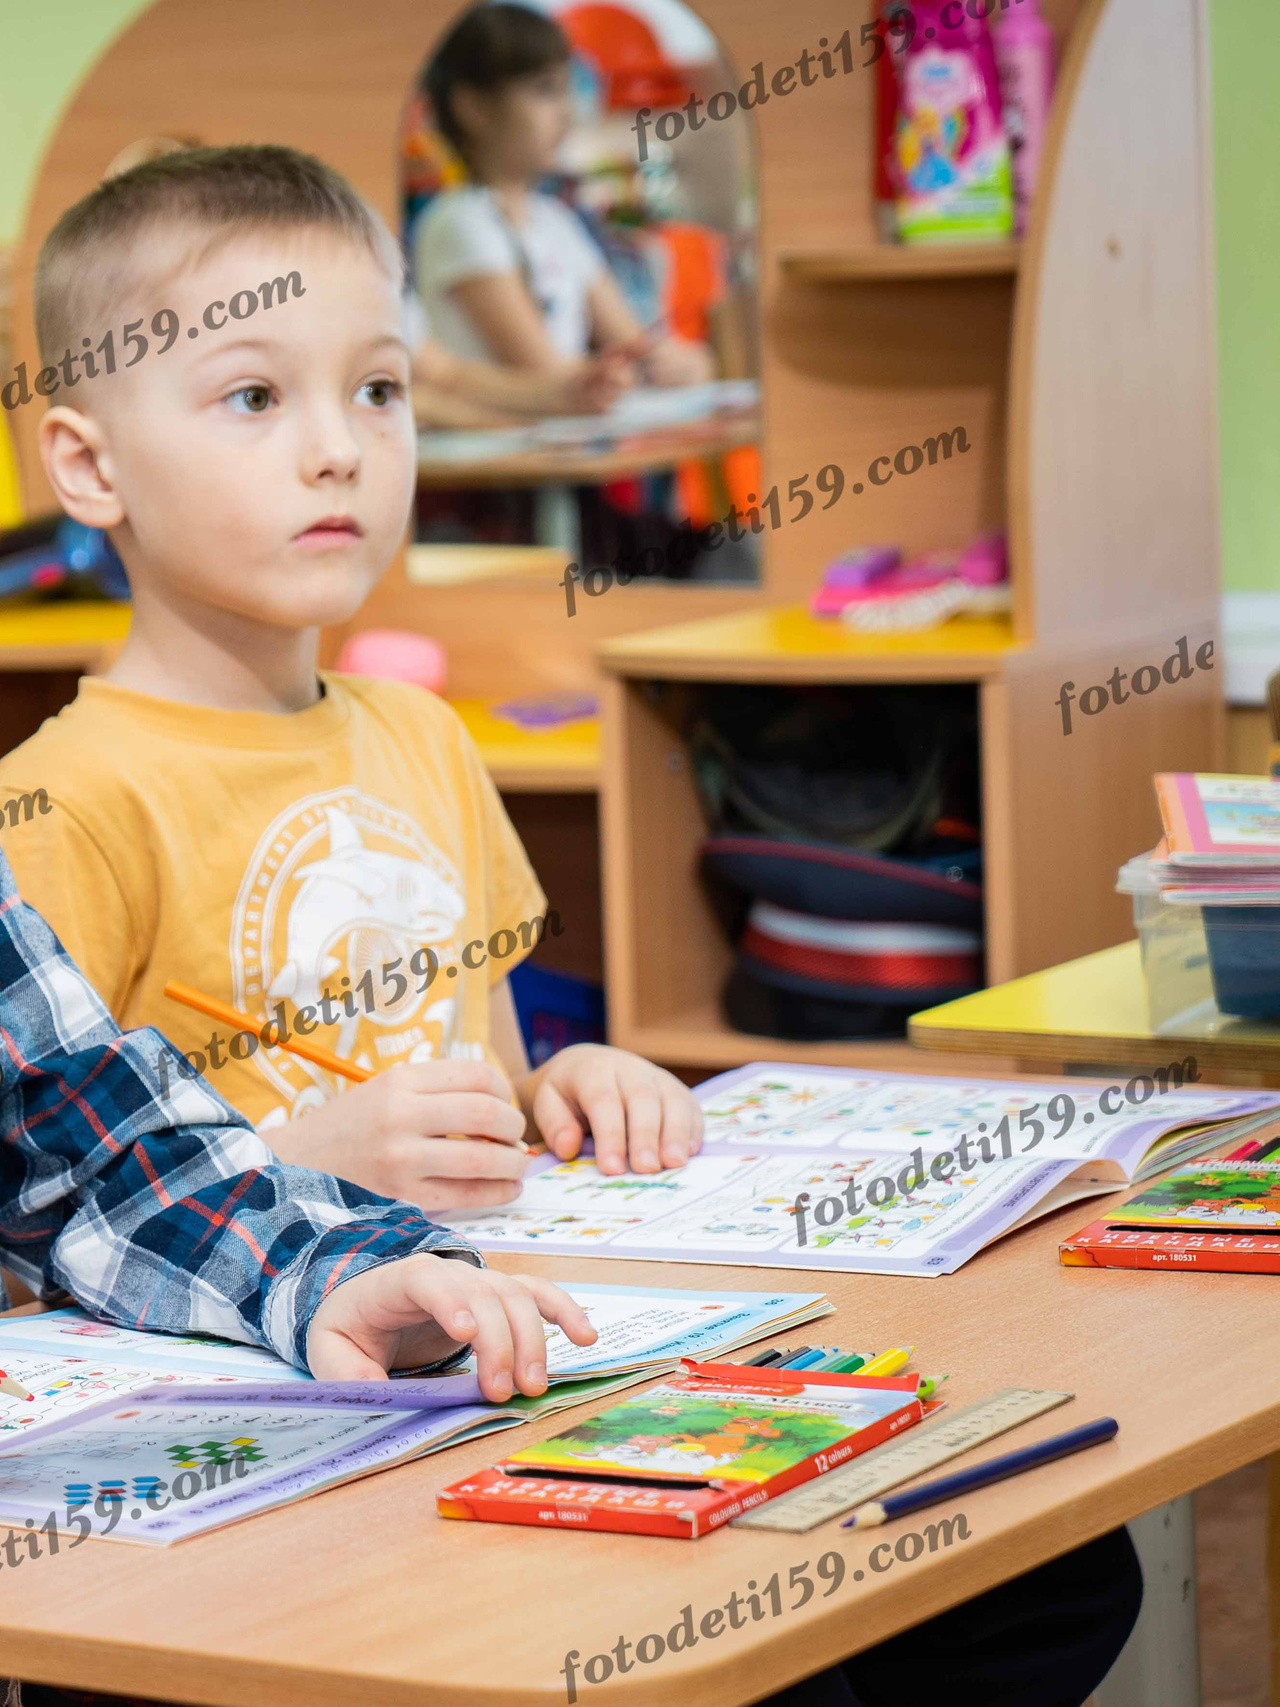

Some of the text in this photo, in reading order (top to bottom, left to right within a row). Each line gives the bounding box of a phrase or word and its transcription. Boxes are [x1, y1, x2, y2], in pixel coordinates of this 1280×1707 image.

[1076, 1236, 1280, 1250] КАРАНДАШИ
[1103, 1233, 1254, 1244] ЦВЕТНЫЕ
[1170, 1253, 1197, 1262] 180531
[704, 1382, 784, 1393] BRAUBERG
[814, 1444, 853, 1474] 12 colours
[708, 1489, 768, 1526] COLOURED PENCILS
[557, 1511, 588, 1522] 180531
